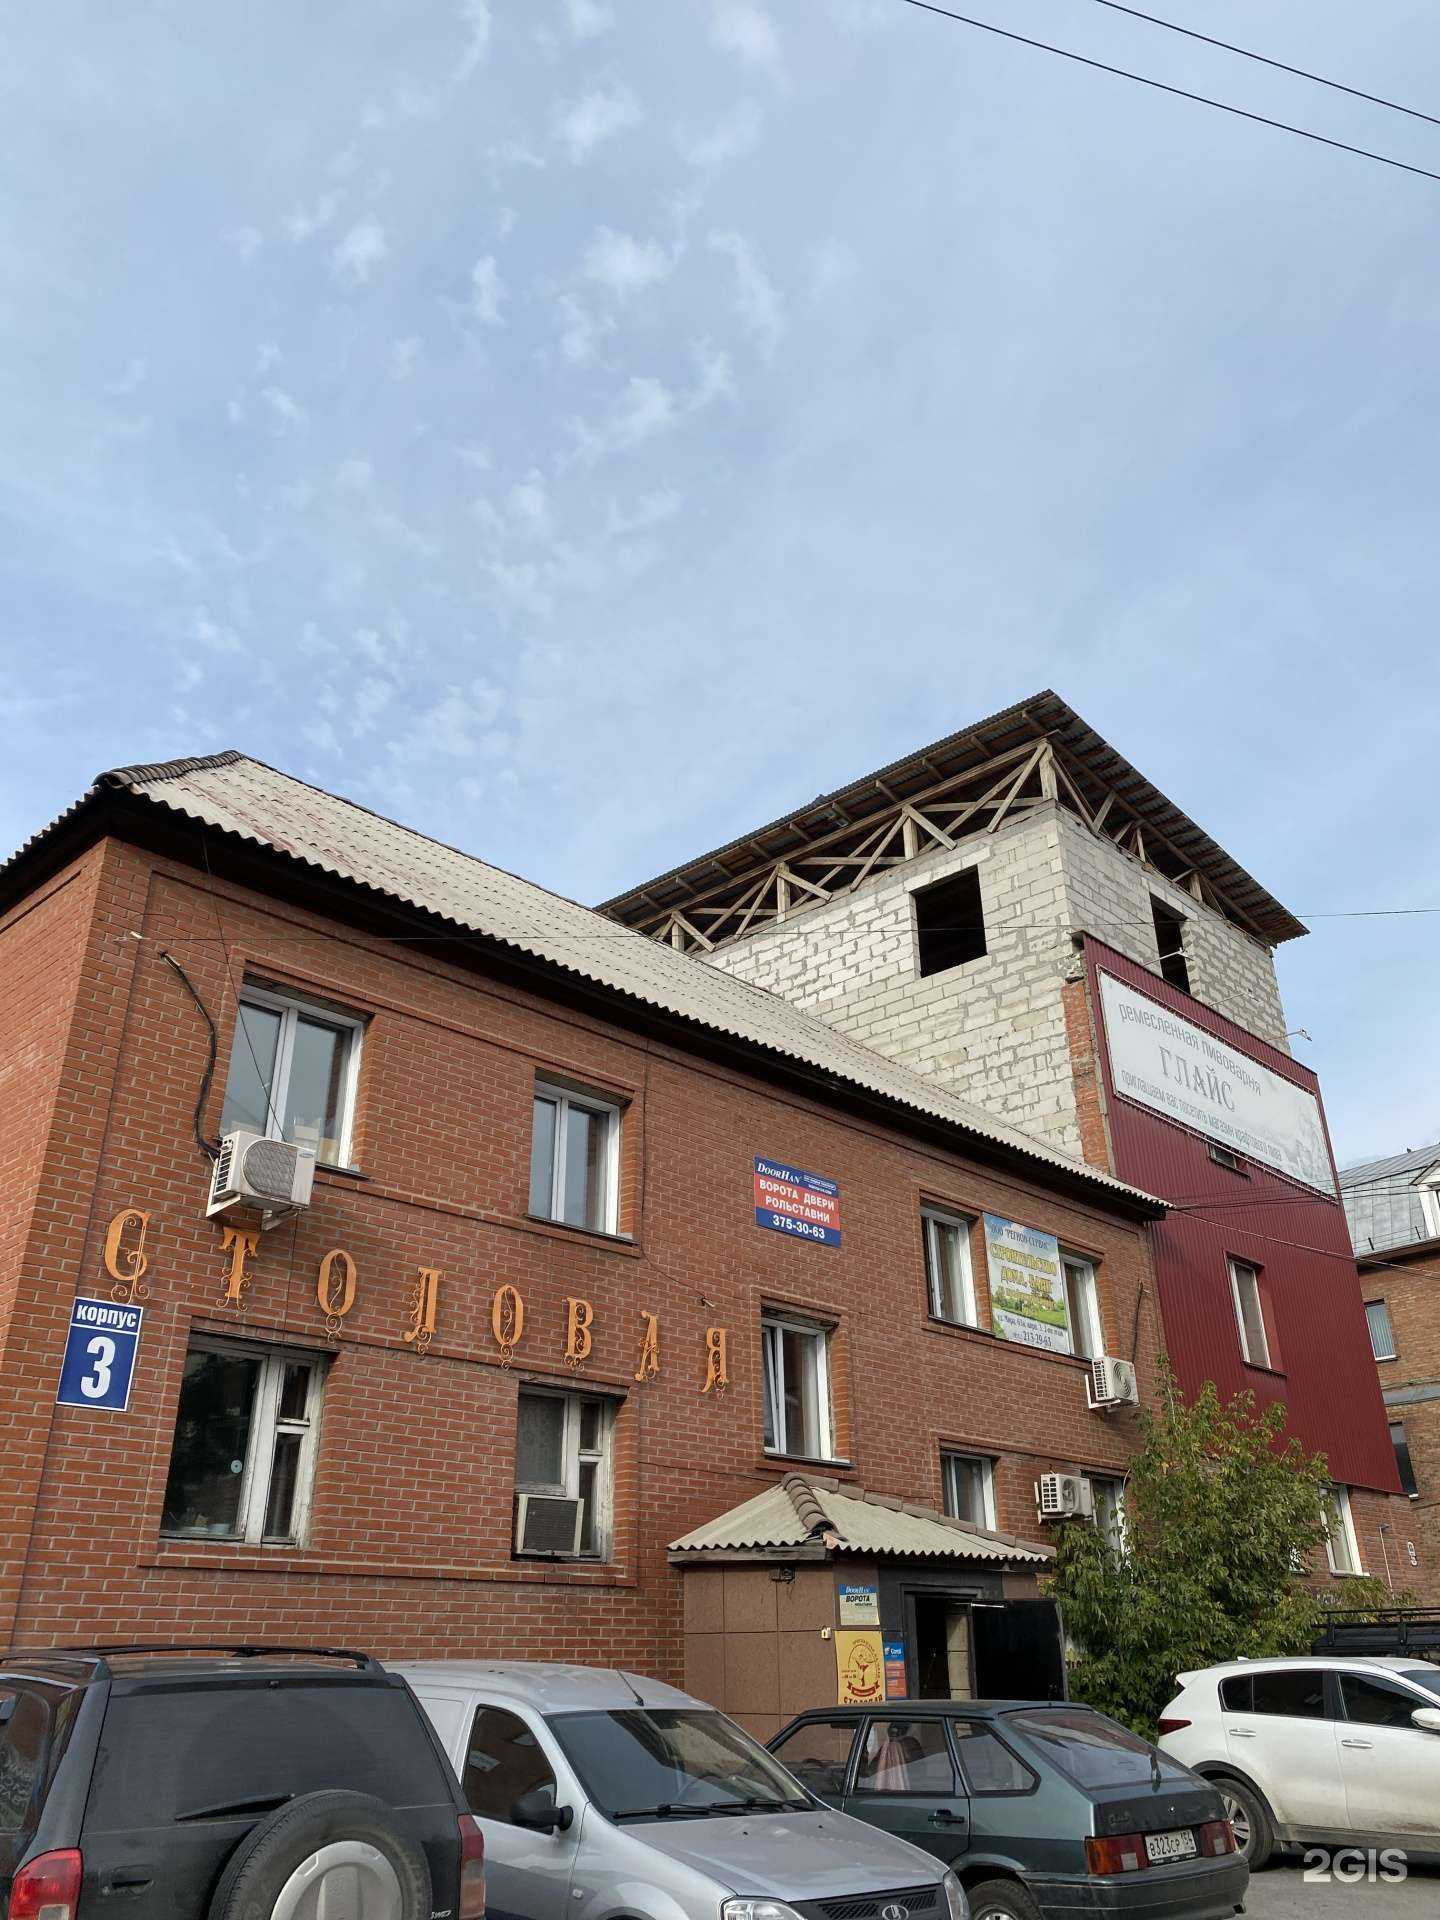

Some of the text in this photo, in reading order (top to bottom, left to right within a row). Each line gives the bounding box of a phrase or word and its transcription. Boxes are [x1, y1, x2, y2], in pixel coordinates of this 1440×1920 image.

[1118, 1003, 1262, 1096] ремесленная пивоварня
[1158, 1045, 1236, 1112] ГЛАЙС
[759, 1179, 799, 1200] ВОРОТА
[803, 1193, 835, 1212] ДВЕРИ
[765, 1195, 831, 1224] РОЛЬСТАВНИ
[772, 1214, 826, 1239] 375-30-63
[76, 1304, 138, 1329] корпус
[104, 1207, 731, 1400] СТОЛОВАЯ
[80, 1336, 116, 1399] 3
[846, 1595, 871, 1603] ВОРОТА
